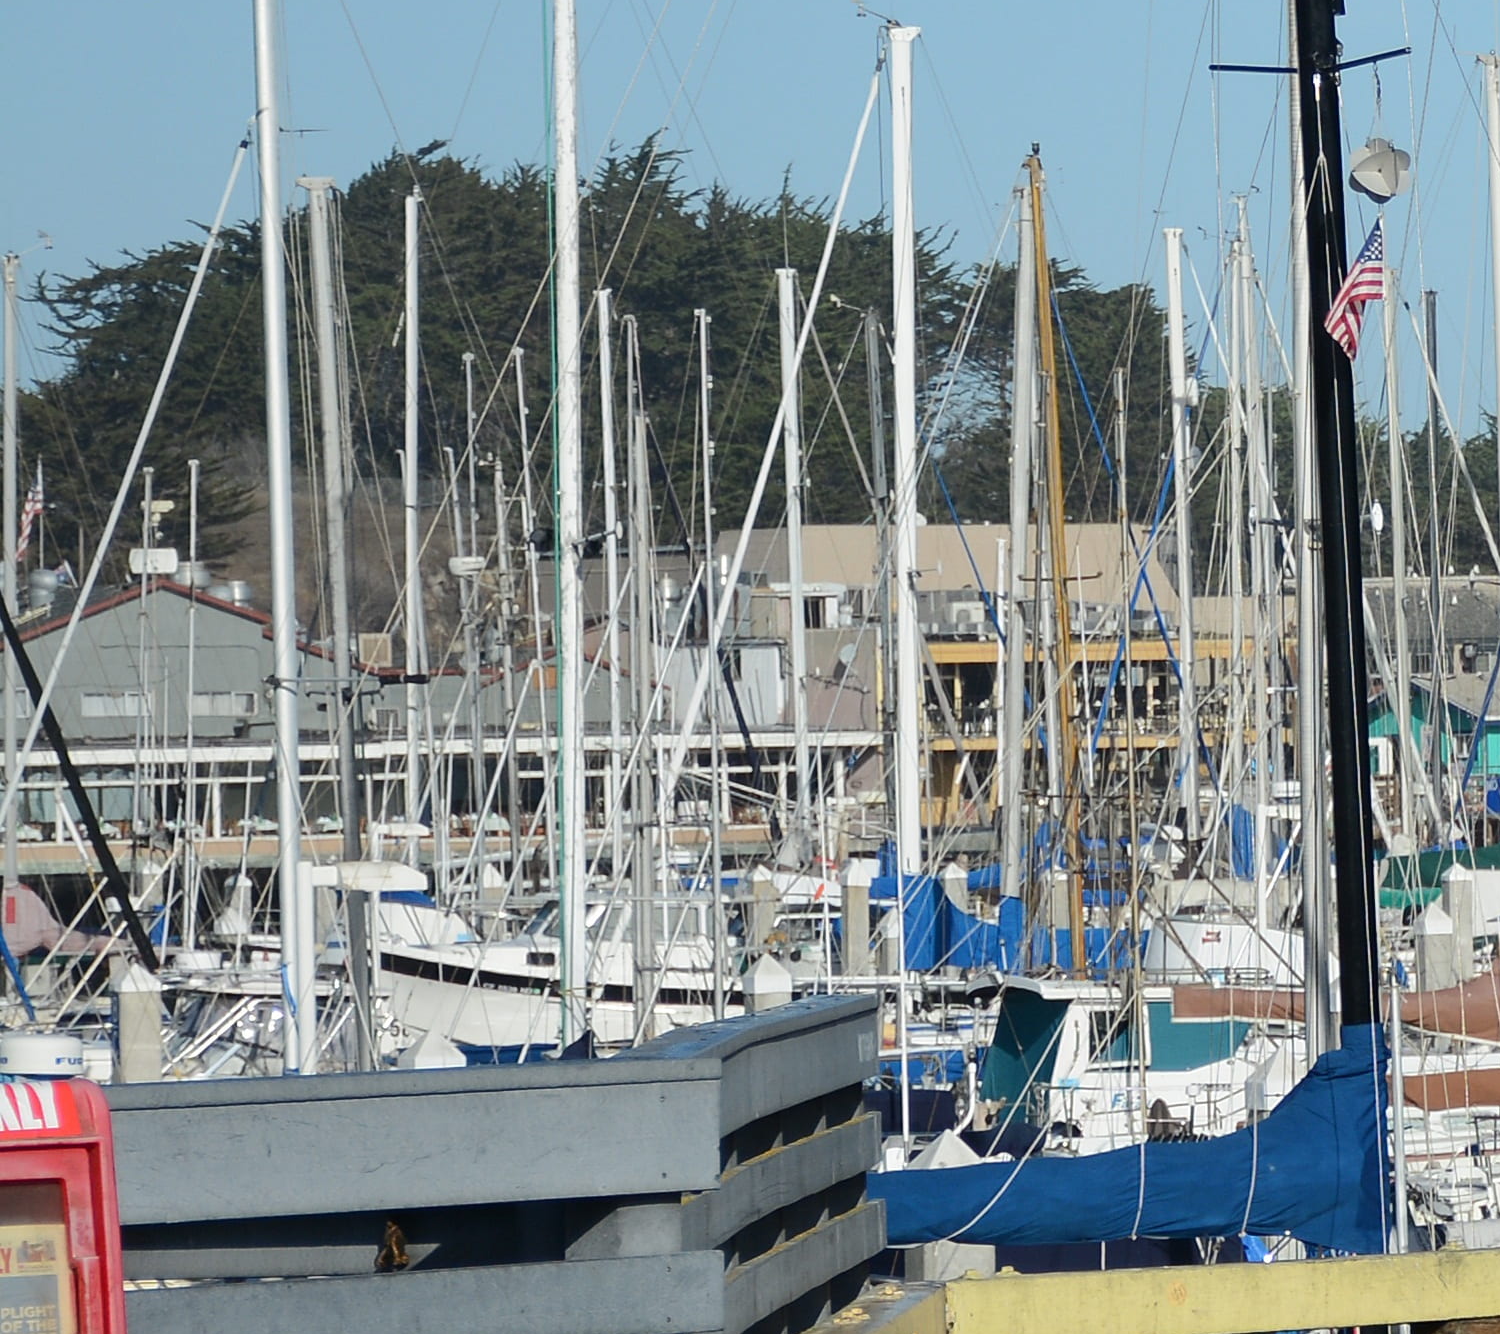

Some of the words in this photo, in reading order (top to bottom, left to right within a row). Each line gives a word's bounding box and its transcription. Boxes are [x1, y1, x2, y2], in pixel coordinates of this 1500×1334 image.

[1, 1305, 56, 1320] PLIGHT
[1, 1320, 22, 1333] OF
[25, 1319, 57, 1332] THE
